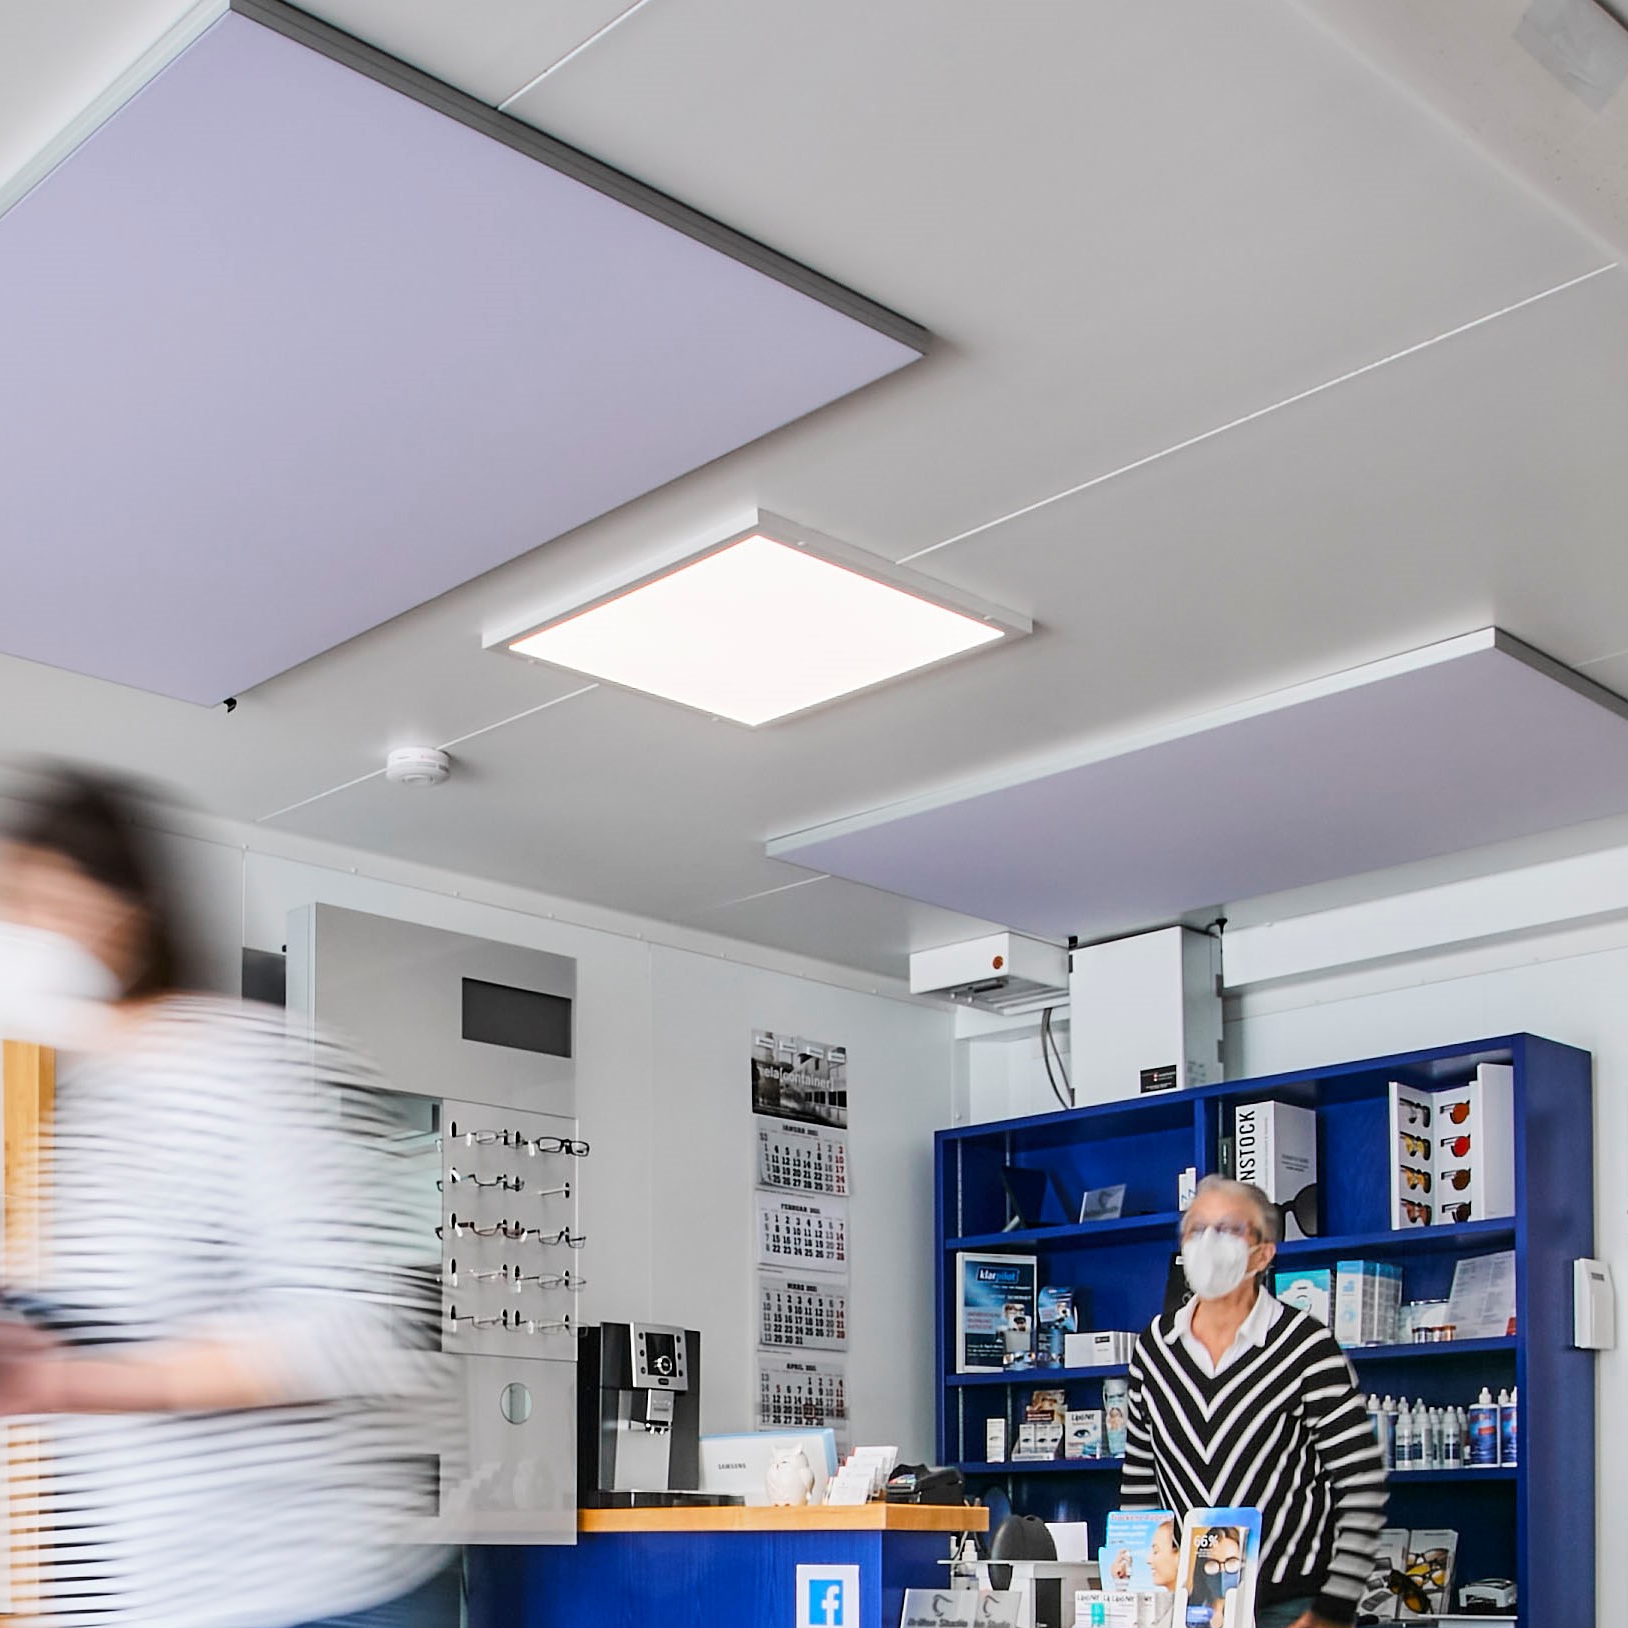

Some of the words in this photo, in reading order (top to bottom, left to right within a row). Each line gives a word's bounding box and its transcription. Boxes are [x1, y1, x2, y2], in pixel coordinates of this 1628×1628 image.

[1239, 1110, 1256, 1186] NSTOCK
[718, 1462, 746, 1470] SAMSUNG
[1194, 1534, 1219, 1548] 66%
